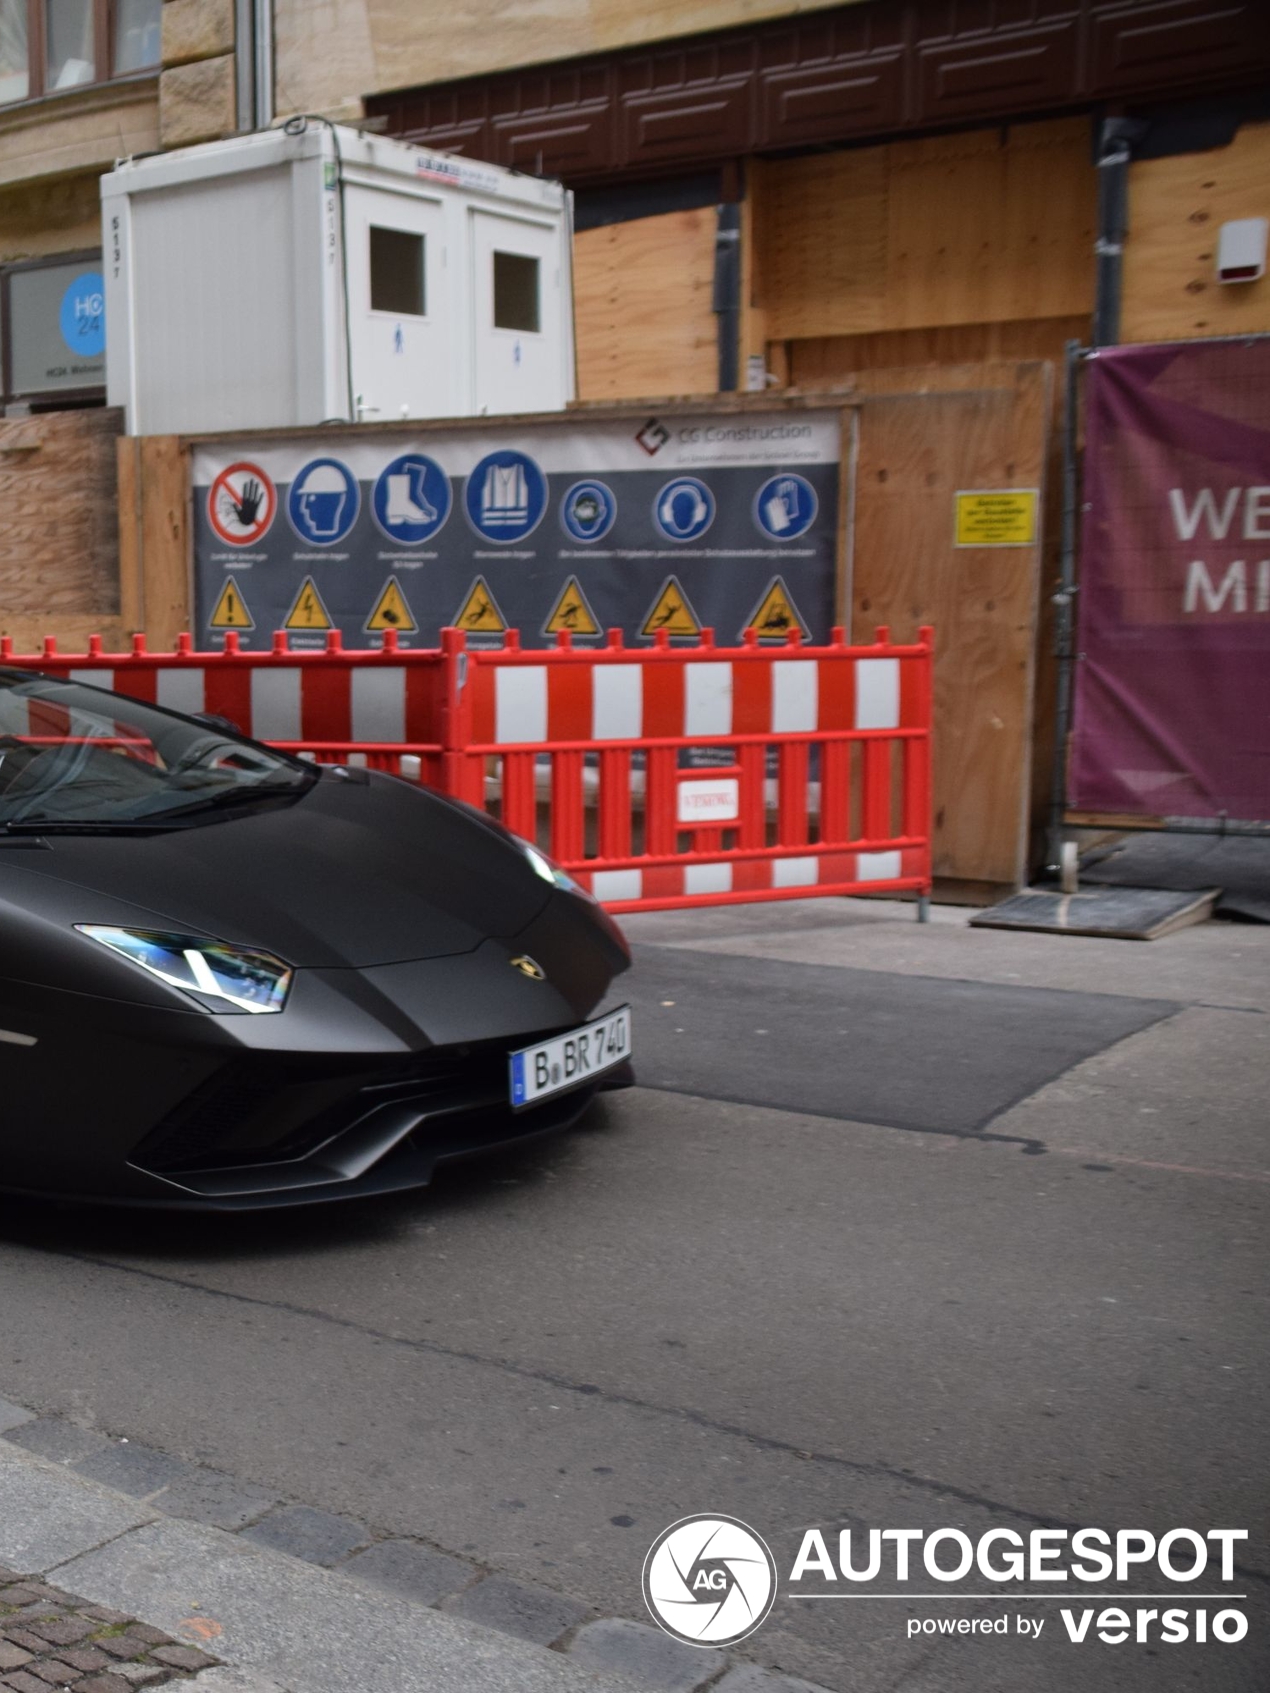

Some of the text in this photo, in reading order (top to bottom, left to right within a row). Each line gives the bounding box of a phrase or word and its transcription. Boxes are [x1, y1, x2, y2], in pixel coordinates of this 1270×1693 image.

[78, 315, 101, 336] 24
[705, 424, 813, 442] Construction
[534, 1017, 626, 1090] B BR 740
